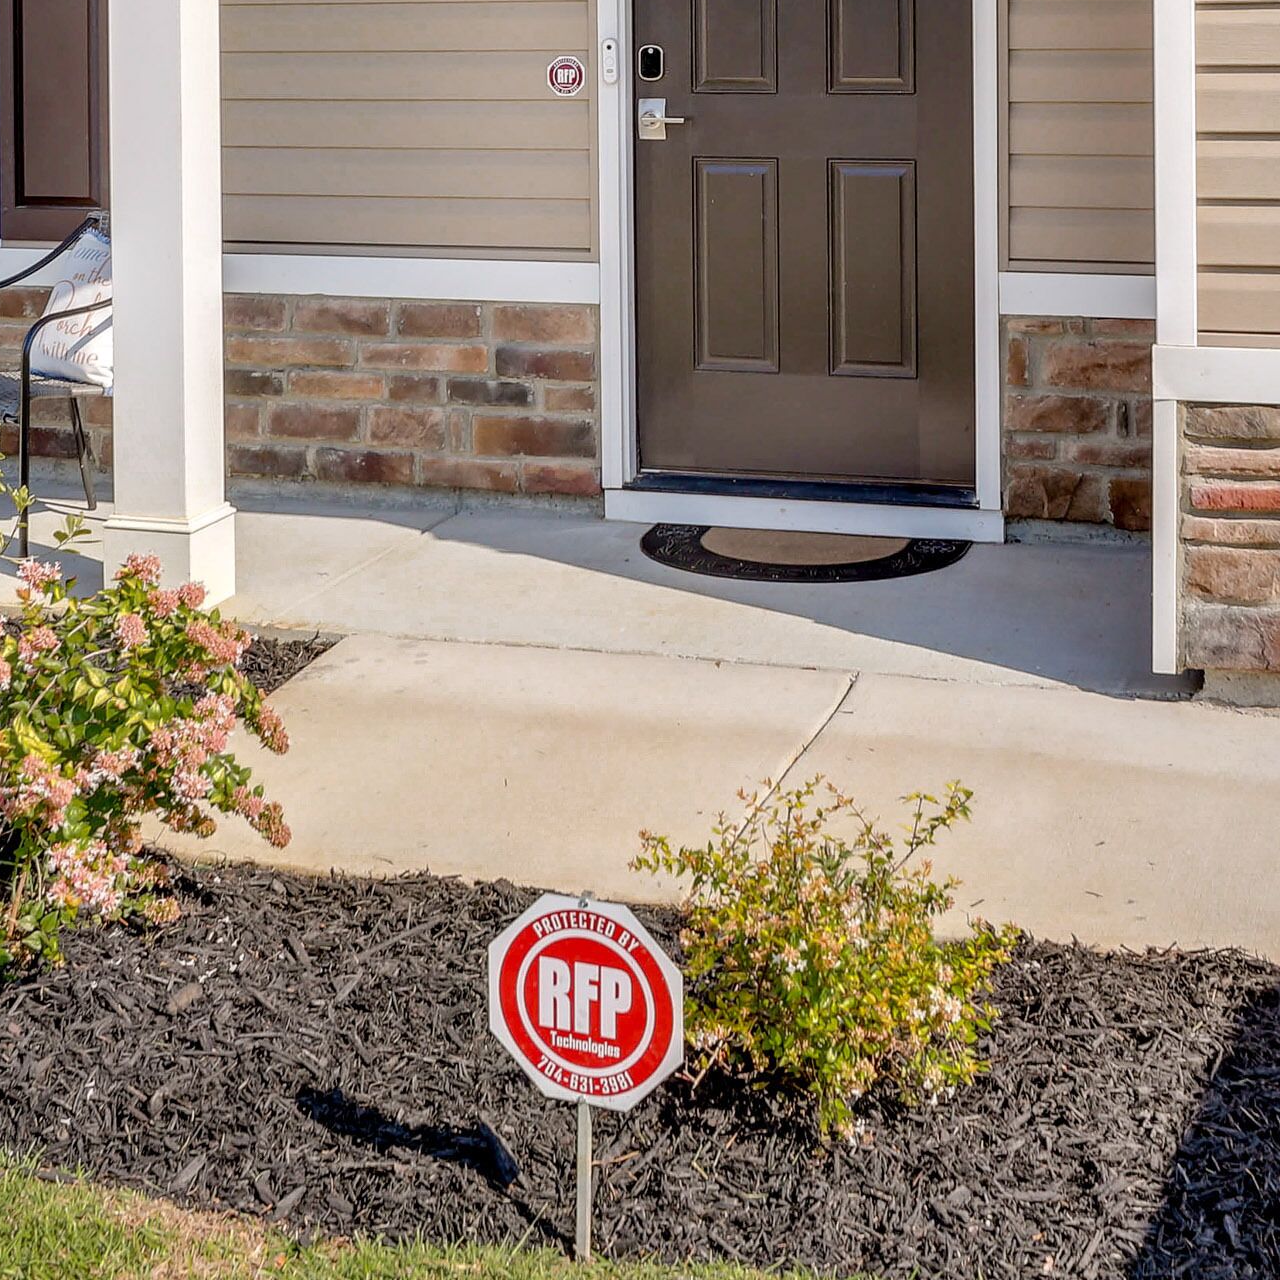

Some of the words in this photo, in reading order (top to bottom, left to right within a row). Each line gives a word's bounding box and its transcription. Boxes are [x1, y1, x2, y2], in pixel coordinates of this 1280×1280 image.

[557, 68, 576, 84] RFP
[73, 246, 110, 262] ome
[532, 911, 616, 939] PROTECTED
[618, 933, 641, 953] BY
[538, 955, 633, 1040] RFP
[550, 1030, 621, 1059] Technologies
[537, 1054, 635, 1094] 704-631-3981
